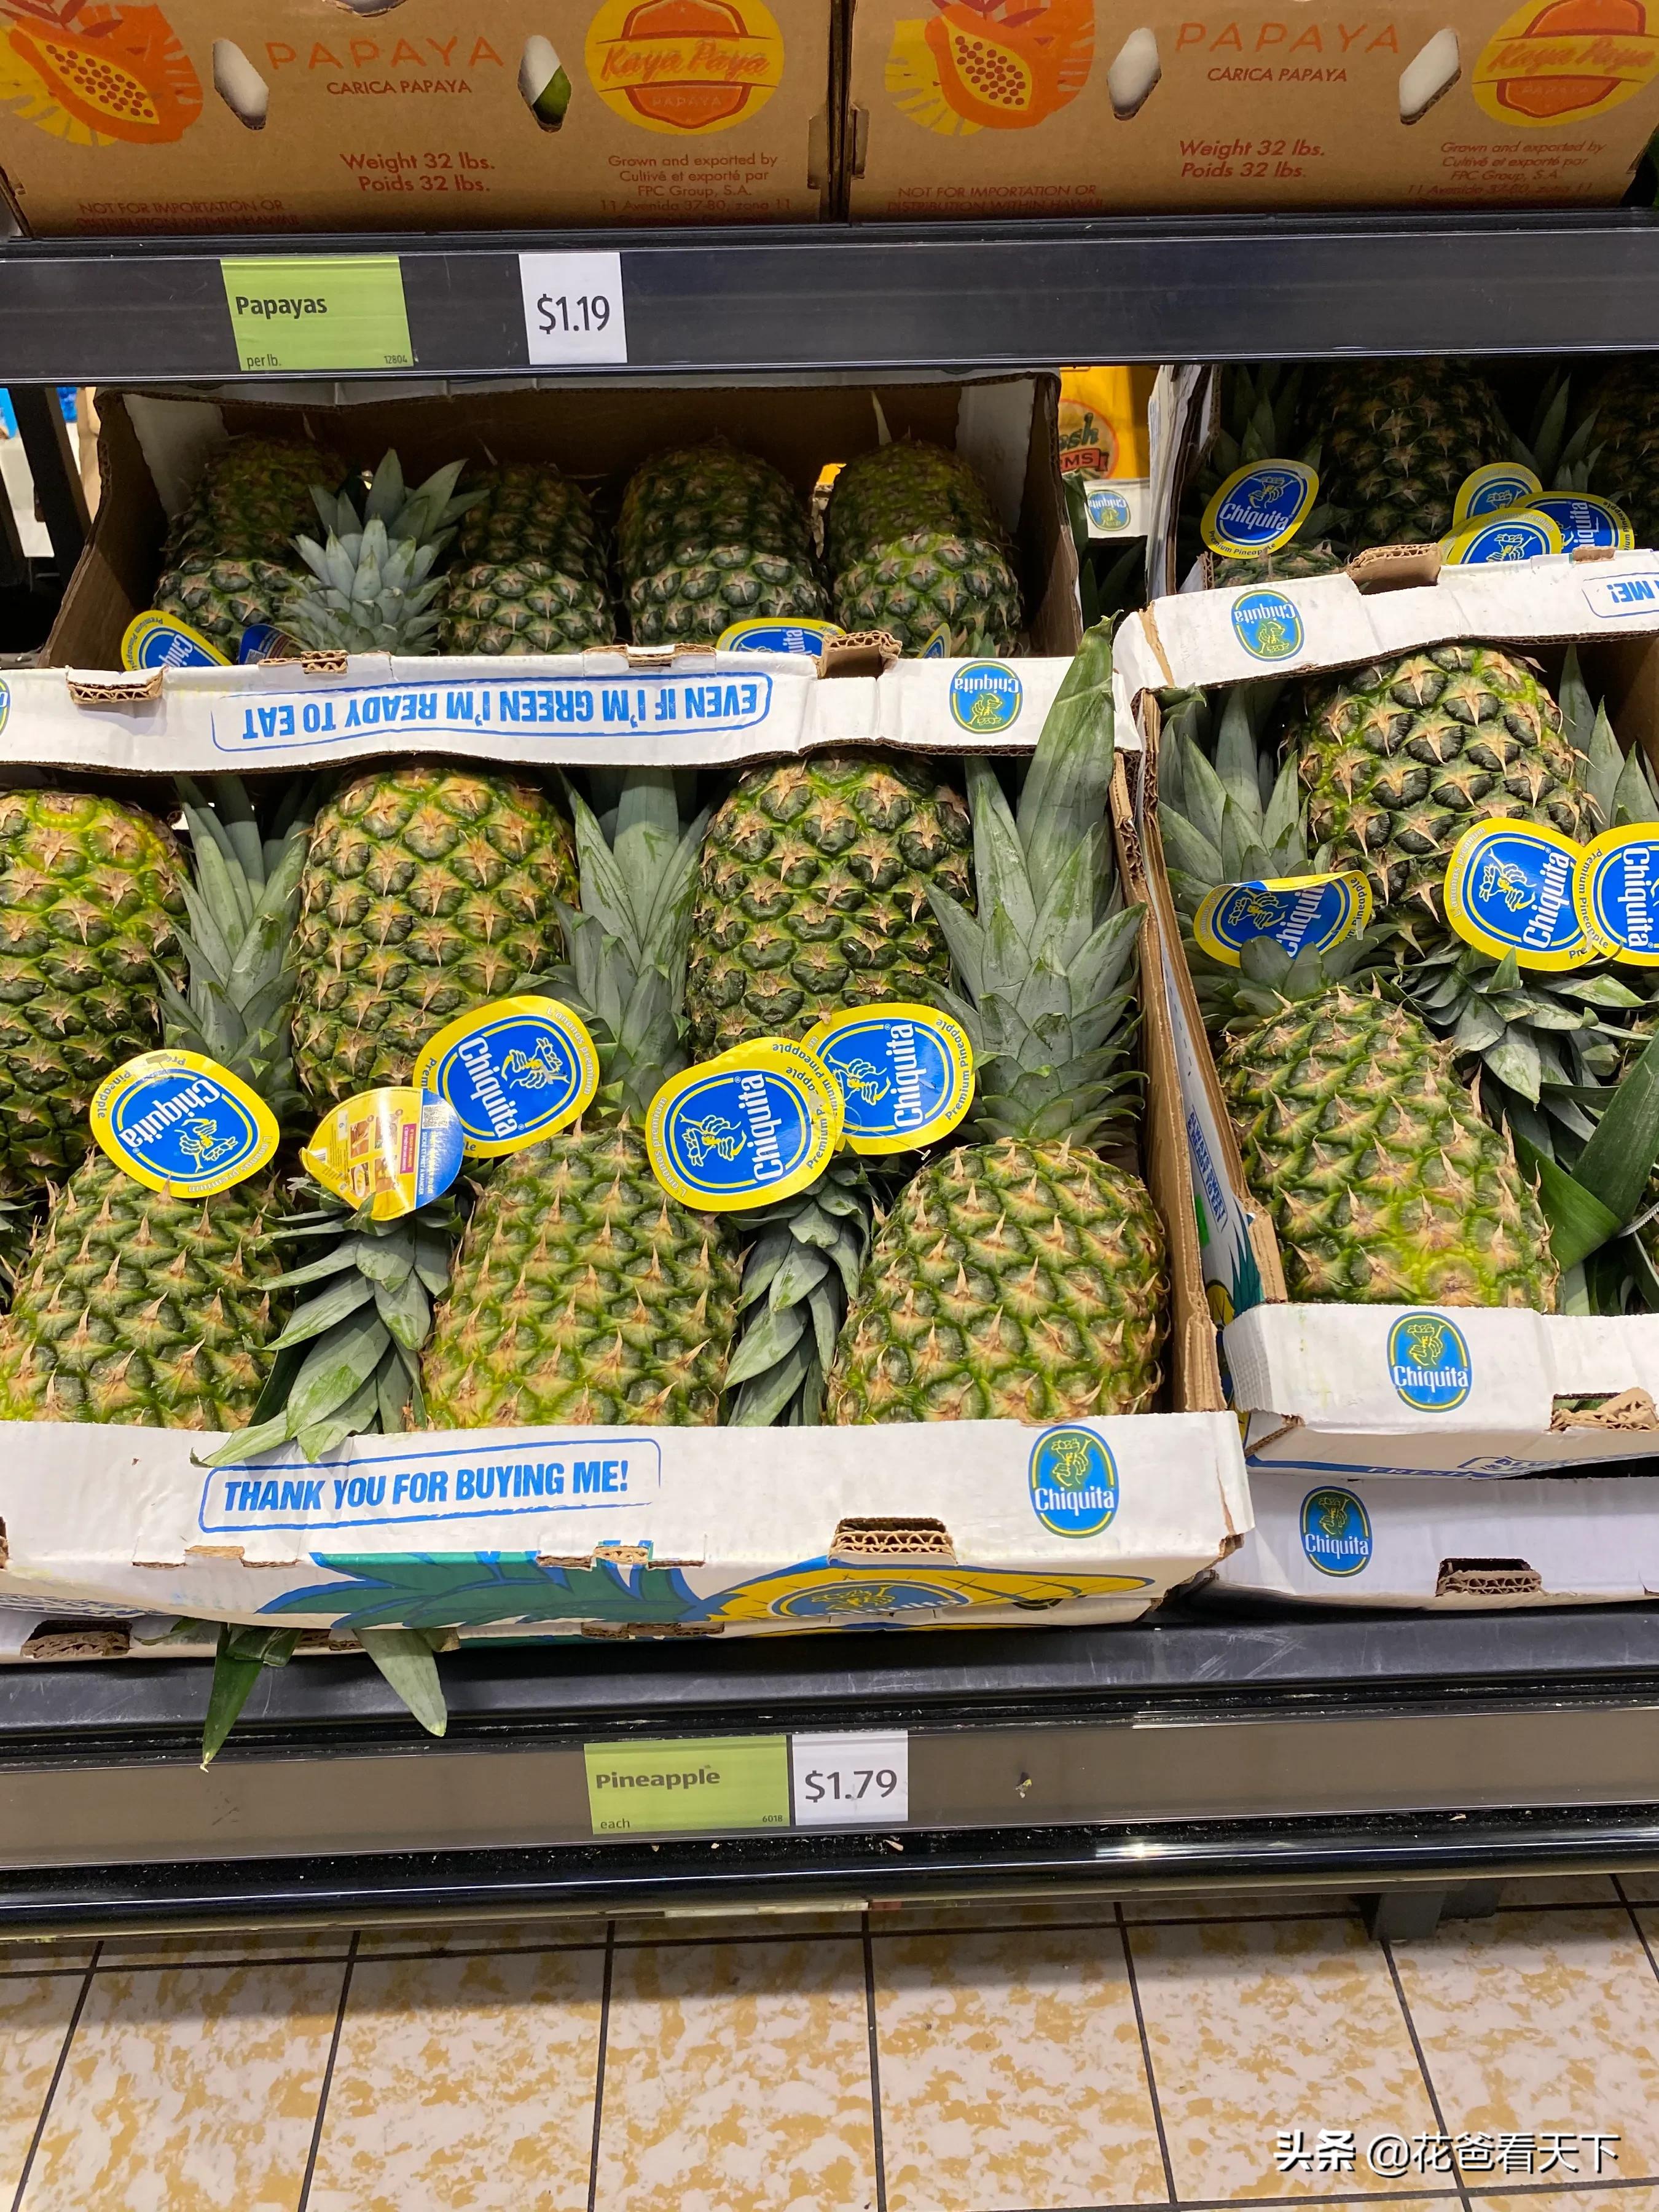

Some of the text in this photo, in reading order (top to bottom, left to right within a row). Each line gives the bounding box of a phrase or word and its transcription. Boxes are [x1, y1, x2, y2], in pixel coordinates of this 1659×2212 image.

[1175, 22, 1400, 53] PAPAYA
[265, 36, 504, 69] PAPAYA
[327, 79, 472, 95] CARICA PAPAYA
[1207, 67, 1347, 82] CARICA PAPAYA
[608, 152, 778, 168] Grown and exported by
[1180, 139, 1325, 160] Weight 32 lbs.
[1440, 140, 1607, 155] Grown and exported by
[340, 152, 495, 173] Weight 32 lbs.
[1181, 161, 1306, 178] Poids 32 lbs.
[1508, 155, 1559, 169] exporté
[1563, 158, 1588, 168] par
[358, 175, 490, 192] Poids 32 lbs.
[619, 170, 769, 184] Cultivé et exporté par
[1451, 171, 1478, 181] FPC
[1481, 170, 1526, 183] Group,
[638, 185, 752, 198] FPC Group, S.A.
[898, 185, 1097, 197] NOT FOR IMPORTATION OR
[79, 200, 284, 214] NOT FOR IMPORTATION OR
[622, 200, 679, 211] Avenida
[736, 202, 769, 211] zona
[235, 296, 327, 320] Papayas
[536, 293, 611, 335] $1.19
[246, 354, 281, 370] per lb.
[384, 355, 408, 364] 12804
[1219, 503, 1289, 531] Chiquita
[1570, 502, 1599, 547] iquita
[1209, 530, 1231, 553] Premium
[1606, 581, 1655, 603] ME!
[1234, 603, 1296, 624] Chiquita
[159, 633, 194, 667] Chiq
[783, 629, 812, 655] uita
[954, 674, 1019, 693] Chiquita
[242, 683, 757, 740] EVEN IF I'M GREEN I'M READY TO EAT
[1457, 827, 1486, 866] premium
[1523, 852, 1570, 949] Chiquita
[1579, 848, 1609, 949] Premium Pineapple
[1617, 847, 1654, 947] Chiquita
[1276, 883, 1327, 958] Chiquit
[546, 1006, 595, 1095] L'ananas premium
[772, 1043, 825, 1078] Pineapple
[886, 1023, 927, 1128] Chiquita
[936, 1019, 970, 1121] Premium Pineapple
[98, 1070, 132, 1119] Pineapple
[458, 1037, 519, 1138] Chiquita
[786, 1066, 826, 1116] Papple
[119, 1078, 222, 1149] Chiquita
[739, 1073, 784, 1182] Chiquita
[653, 1096, 687, 1198] L'ananas premium
[806, 1118, 828, 1169] Premium
[188, 1135, 273, 1193] L'ananas premium
[1392, 1365, 1468, 1393] Chiquita
[225, 1460, 629, 1512] THANK YOU FOR BUYING ME!
[1034, 1485, 1115, 1516] Chiquita
[1305, 1533, 1369, 1557] Chiquita
[596, 1768, 721, 1790] Pineapple
[805, 1769, 898, 1803] $1.79
[600, 1817, 630, 1829] each
